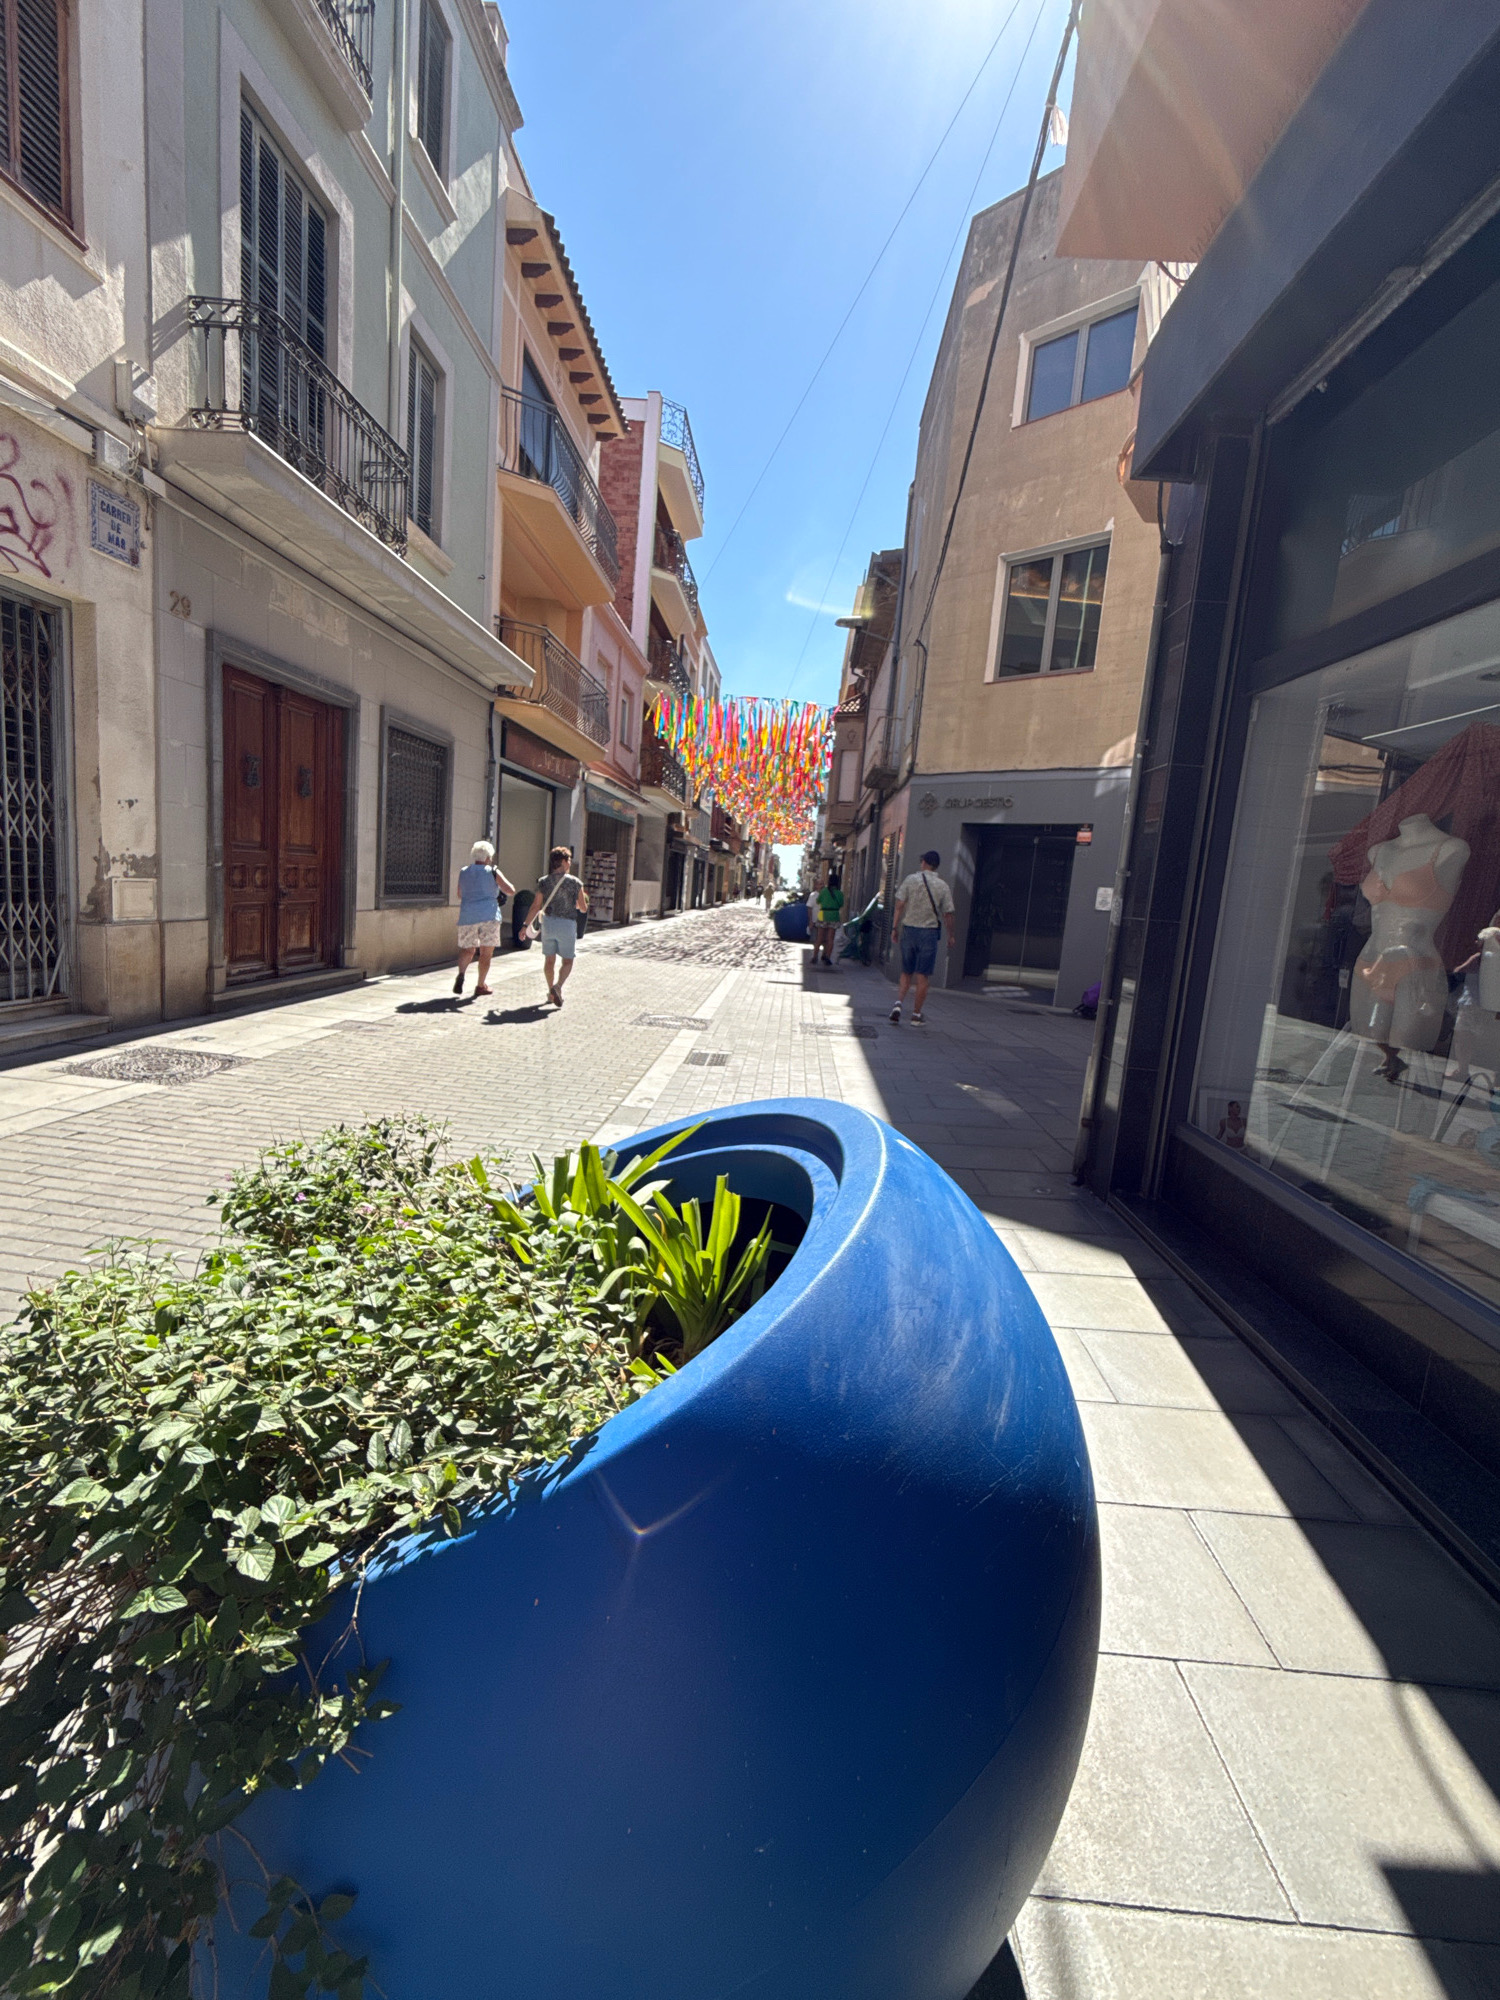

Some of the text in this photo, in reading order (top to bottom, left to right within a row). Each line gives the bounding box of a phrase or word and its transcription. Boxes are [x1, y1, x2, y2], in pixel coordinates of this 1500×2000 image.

[100, 500, 132, 526] CARRER
[110, 519, 122, 535] DE
[107, 532, 126, 550] MAR
